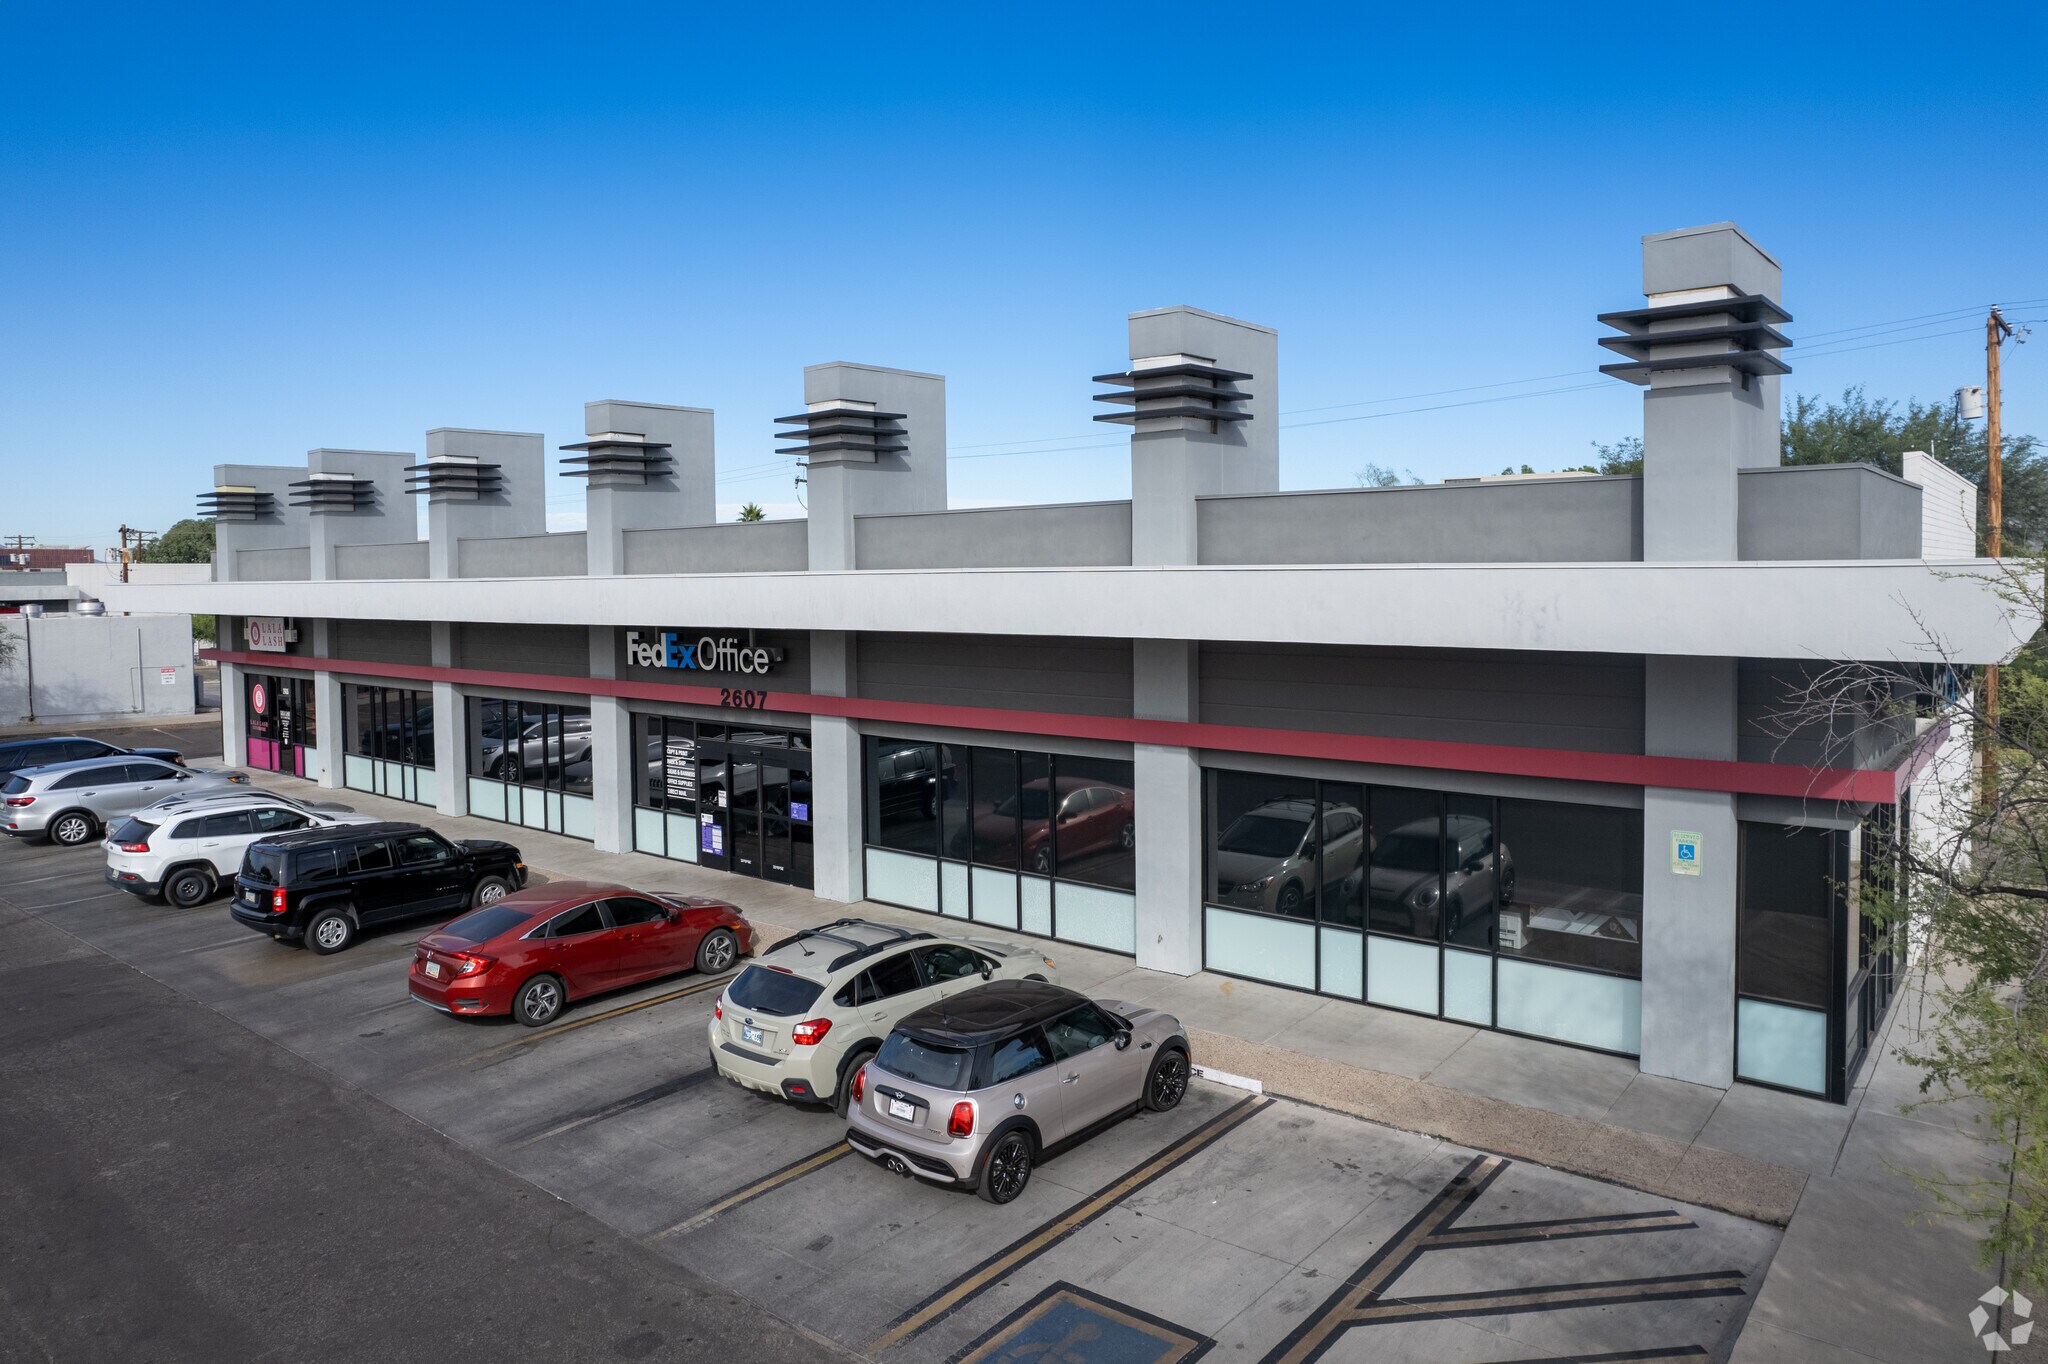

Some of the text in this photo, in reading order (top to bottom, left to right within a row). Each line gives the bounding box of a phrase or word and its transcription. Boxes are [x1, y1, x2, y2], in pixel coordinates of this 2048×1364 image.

[262, 623, 282, 634] LALA
[262, 635, 283, 647] LASH
[627, 631, 769, 674] FedEx Office
[721, 688, 768, 710] 2607
